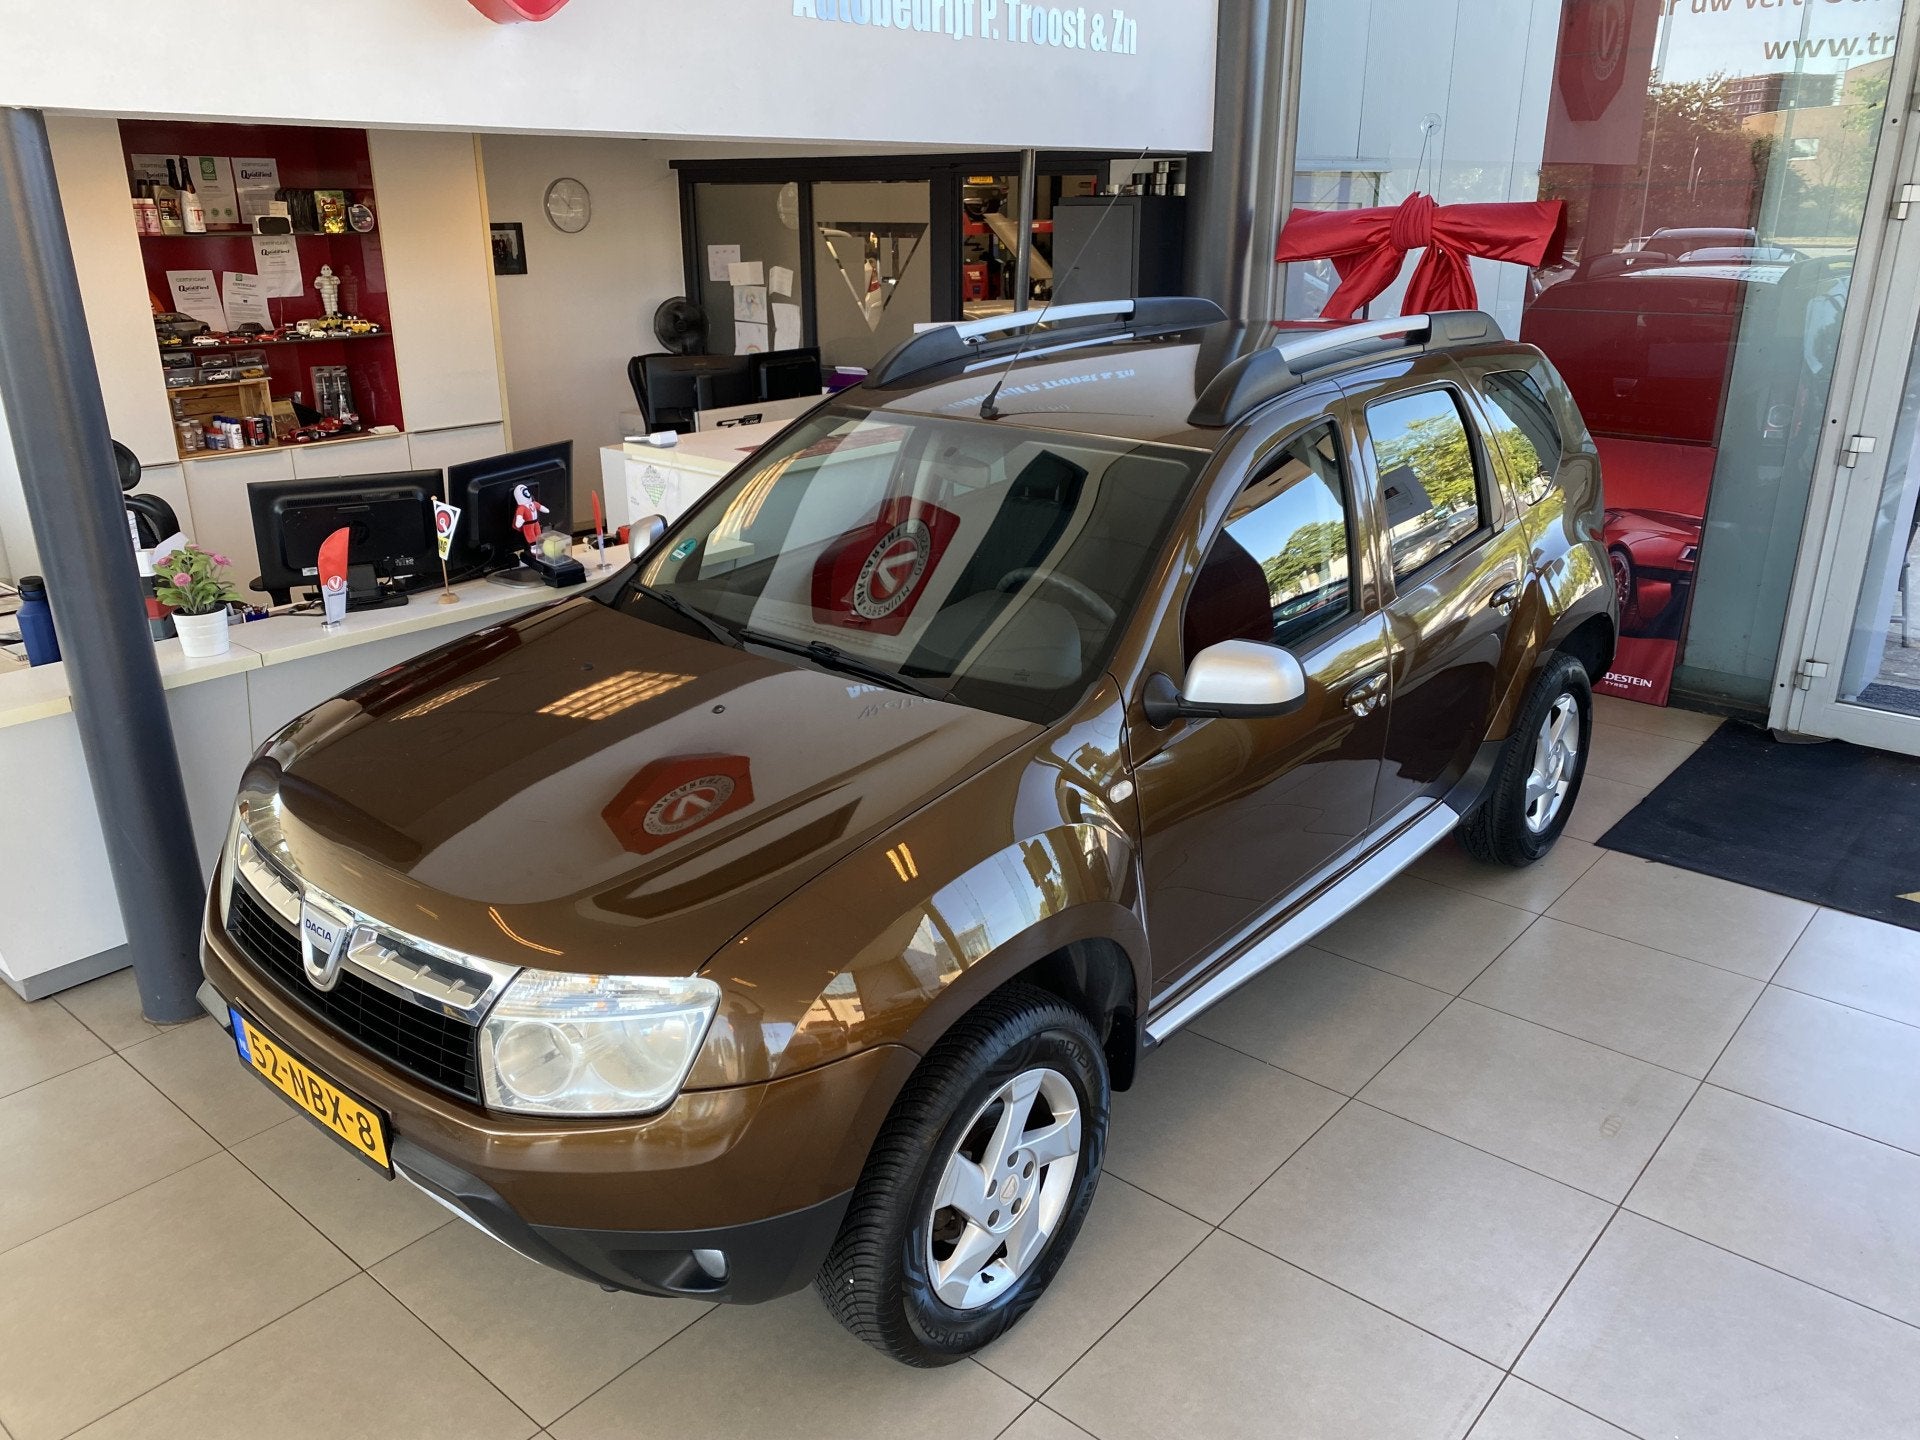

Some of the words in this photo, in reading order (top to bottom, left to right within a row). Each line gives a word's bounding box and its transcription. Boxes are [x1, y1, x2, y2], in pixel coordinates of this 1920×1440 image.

[1005, 0, 1087, 49] Troost
[1090, 13, 1107, 52] &
[1111, 9, 1137, 55] Zn
[1602, 672, 1653, 688] DESTEIN
[305, 918, 332, 943] DACIA
[249, 1030, 376, 1151] 52-NBX-8
